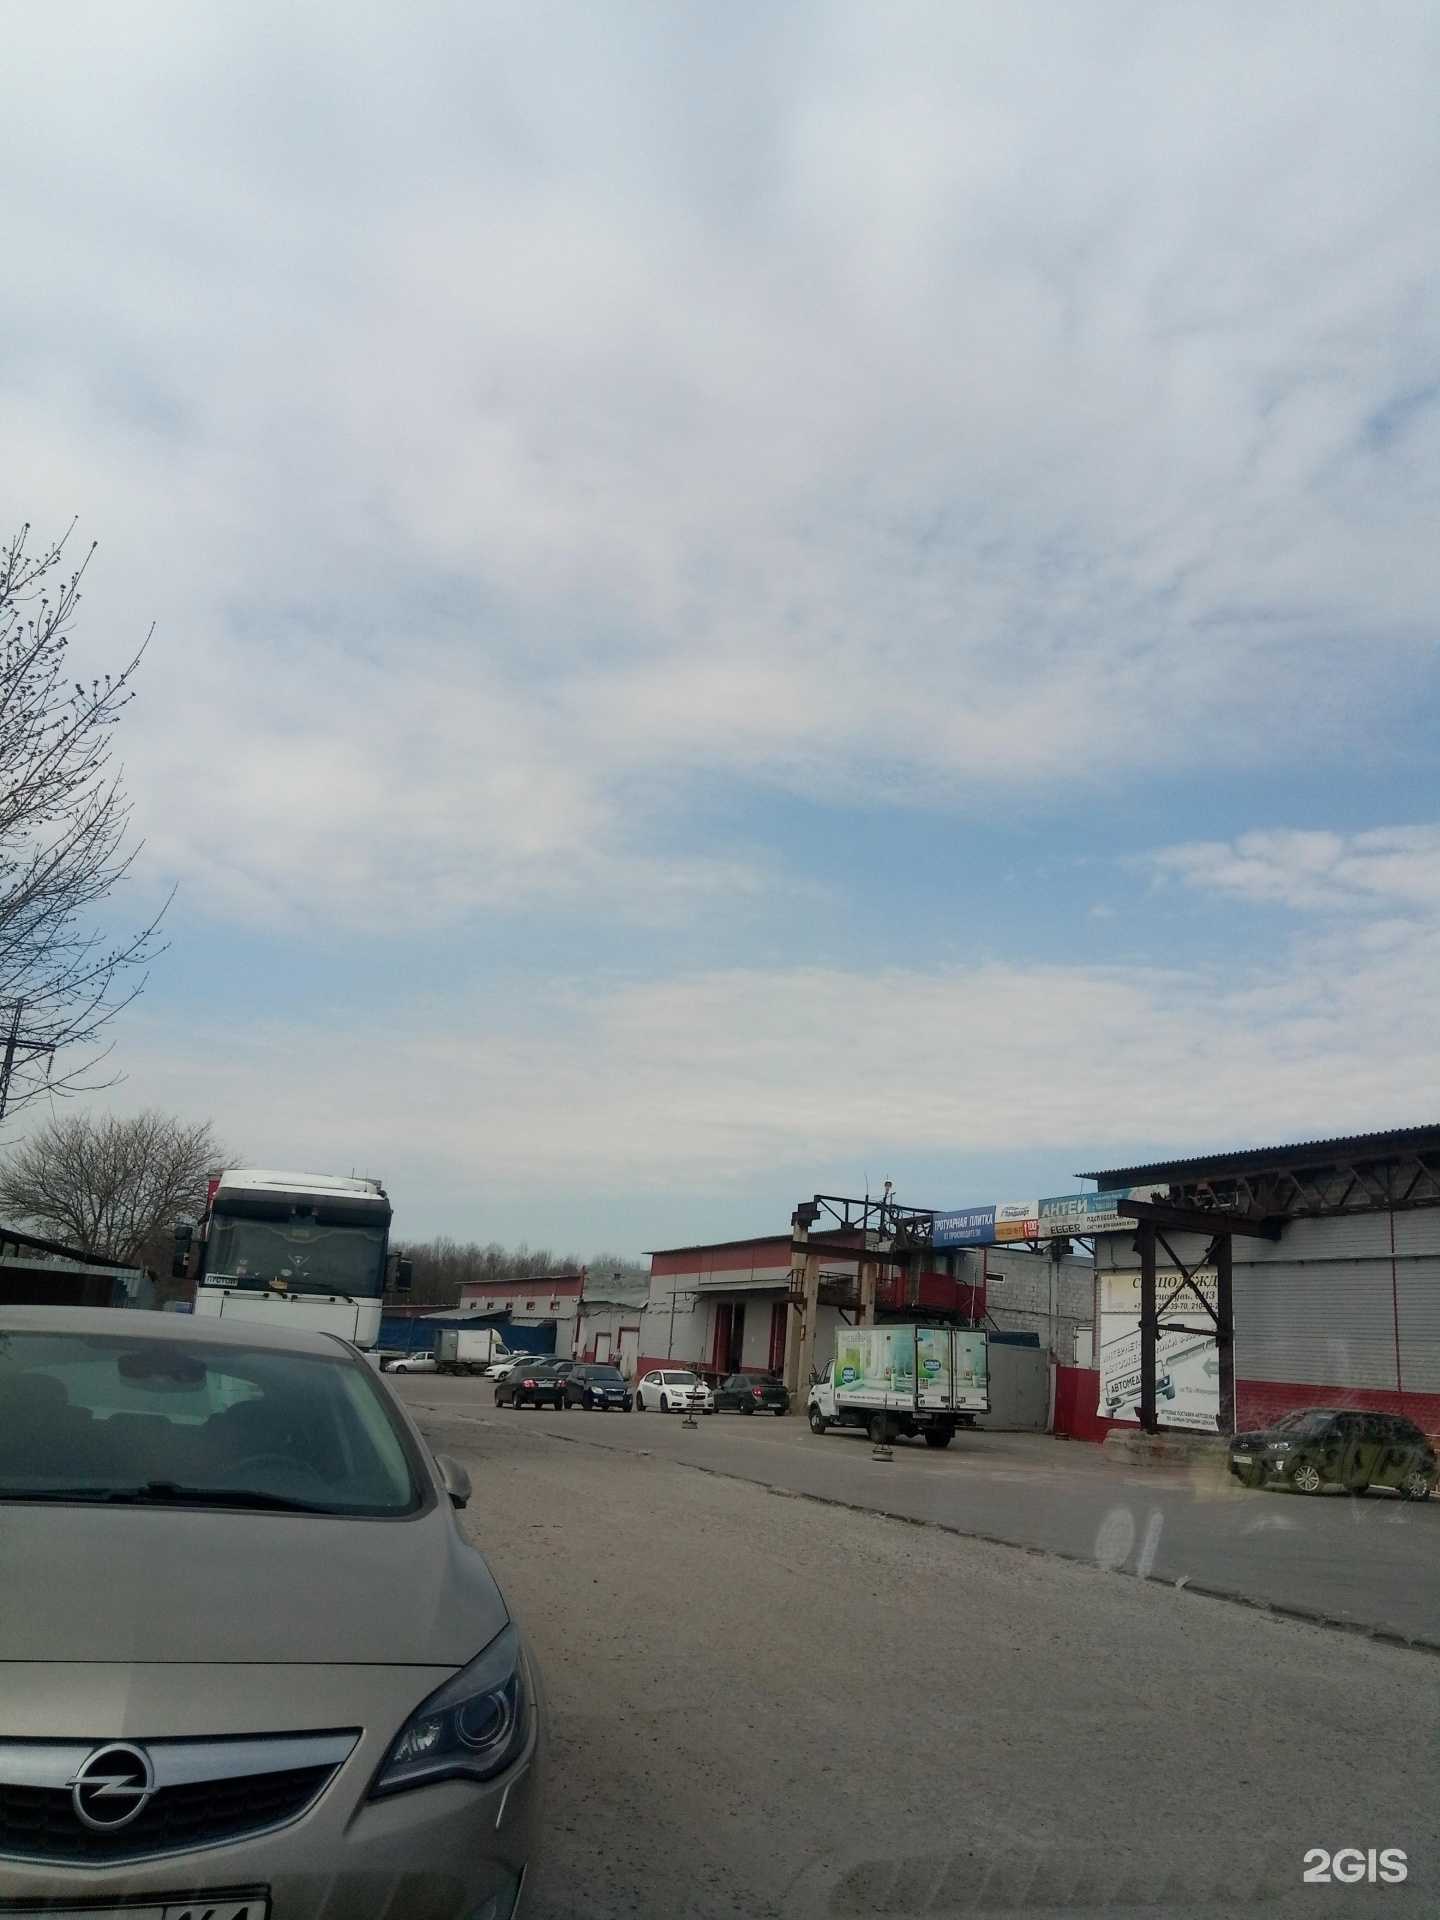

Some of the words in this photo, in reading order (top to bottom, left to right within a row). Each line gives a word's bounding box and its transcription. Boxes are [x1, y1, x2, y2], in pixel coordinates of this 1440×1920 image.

[1042, 1196, 1088, 1217] АНТЕЙ
[935, 1217, 968, 1232] ТРОТУАРНАЯ
[970, 1214, 993, 1227] ПЛИТКА
[1051, 1224, 1081, 1235] EGGER
[1111, 1374, 1142, 1393] АВТОМЕД
